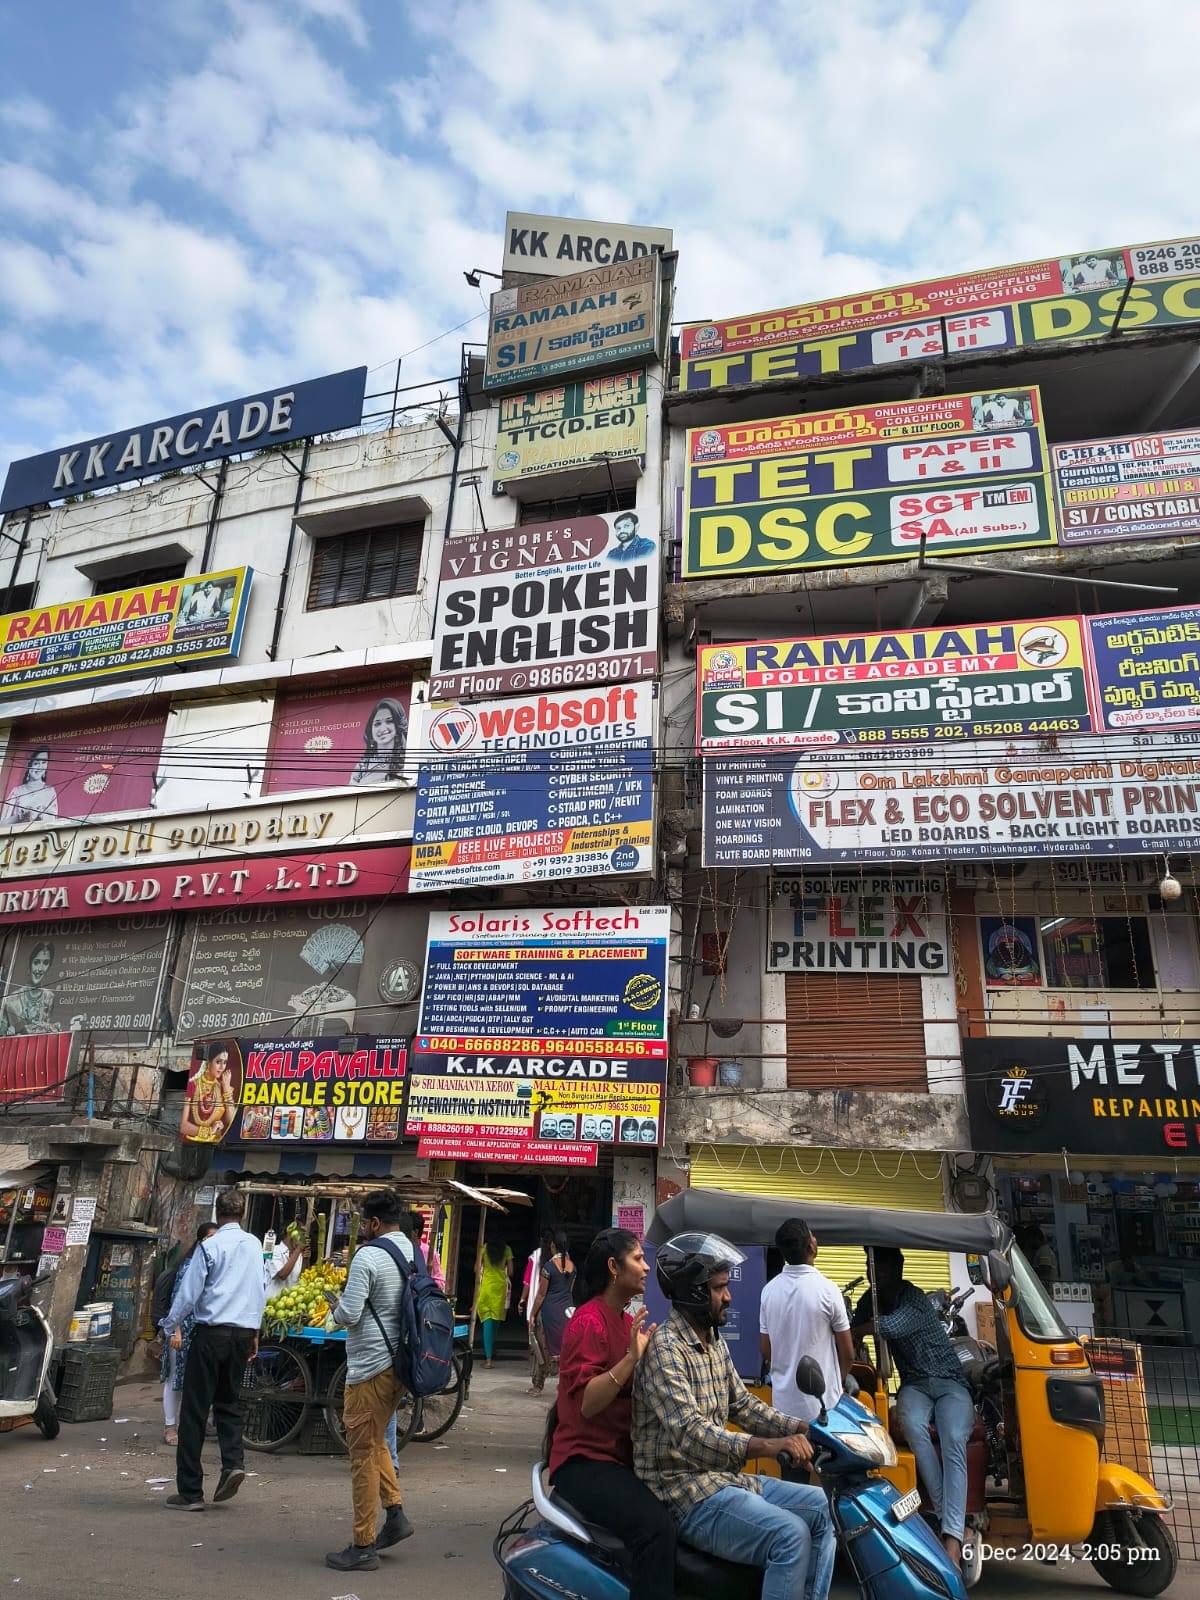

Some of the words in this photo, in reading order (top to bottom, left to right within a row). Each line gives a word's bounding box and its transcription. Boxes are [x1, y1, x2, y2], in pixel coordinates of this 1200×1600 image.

[509, 228, 549, 258] KK
[1136, 248, 1176, 261] 9246
[1139, 263, 1168, 275] 888
[928, 271, 1051, 300] ONLINE/OFFLINE
[944, 284, 1037, 307] COACHING
[494, 291, 617, 333] RAMAIAH
[885, 316, 991, 344] PAPER
[496, 341, 527, 369] SI
[694, 335, 858, 389] TET
[585, 370, 642, 398] NEET
[502, 388, 565, 421] IIT-JEE
[584, 388, 640, 410] EAMCET
[875, 401, 963, 417] ONLINE/OFFLINE
[508, 408, 635, 446] TTC(D.Ed)
[887, 412, 953, 426] COACHING
[930, 421, 960, 430] FLOOR
[115, 391, 297, 474] ARCADE
[902, 437, 1016, 460] PAPER
[1135, 439, 1160, 458] DSC
[941, 460, 966, 472] &
[979, 456, 1001, 469] II
[1060, 464, 1116, 478] Gurukula
[698, 448, 873, 504] TET
[1063, 474, 1119, 488] Teachers
[899, 491, 980, 517] SGT
[985, 491, 1005, 505] TM
[1009, 490, 1028, 503] EM
[1067, 487, 1119, 503] GROUP
[1069, 509, 1088, 525] SI
[1105, 500, 1200, 521] CONSTABL
[469, 528, 573, 554] KISHORE'S
[700, 502, 873, 568] DSC
[900, 518, 954, 541] SA
[449, 538, 593, 577] VIGNAN
[444, 565, 648, 627] SPOKEN
[7, 584, 180, 642] RAMAIAH
[6, 633, 71, 652] COMPETITIVE
[72, 623, 125, 640] COACHING
[127, 613, 170, 629] CENTER
[85, 634, 122, 646] GURUKULA
[439, 609, 648, 671] ENGLISH
[85, 641, 120, 653] TEACHERS
[746, 626, 1015, 671] RAMAIAH
[2, 673, 22, 684] K.K.
[24, 667, 60, 680] Arcade
[61, 663, 78, 673] Ph:
[80, 657, 105, 670] 9246
[108, 653, 127, 665] 208
[129, 645, 173, 660] 422,888
[176, 640, 203, 653] 5555
[206, 635, 227, 648] 202
[762, 666, 857, 685] POLICE
[867, 655, 999, 678] ACADEMY
[431, 679, 455, 697] 2nd
[460, 675, 502, 695] Floor
[529, 657, 643, 688] 9866293071
[479, 687, 639, 739] websoft
[714, 691, 783, 733] SI
[481, 722, 637, 753] TECHNOLOGIES
[859, 729, 886, 741] 888
[892, 727, 929, 740] 5555
[934, 724, 968, 739] 202,
[973, 722, 1023, 737] 85208
[1029, 719, 1081, 734] 44463
[746, 773, 784, 783] PRINTING
[860, 772, 897, 789] Om
[903, 768, 988, 788] Lakshmi
[995, 761, 1113, 785] Ganapathi
[427, 807, 447, 818] DATA
[449, 801, 494, 816] ANALYTICS
[558, 801, 587, 813] STAAD
[716, 803, 765, 814] LAMINATION
[809, 798, 877, 828] FLEX
[884, 799, 905, 825] &
[914, 794, 970, 825] ECO
[978, 787, 1114, 822] SOLVENT
[1122, 784, 1200, 816] PRIN
[448, 827, 474, 840] AZURE
[475, 823, 504, 837] CLOUD,
[506, 820, 538, 833] DEVOPS
[573, 827, 620, 840] Internships
[716, 820, 732, 829] ONE
[734, 819, 752, 828] WAY
[754, 818, 781, 827] VISION
[881, 828, 913, 844] LED
[919, 825, 990, 843] BOARDS
[1010, 823, 1059, 839] BACK
[1066, 820, 1120, 837] LIGHT
[79, 822, 155, 863] gold
[168, 809, 334, 849] company
[458, 841, 480, 854] IEEE
[484, 838, 506, 852] LIVE
[509, 832, 564, 848] PROJECTS
[571, 839, 612, 850] Industrial
[615, 835, 650, 847] Training
[716, 834, 763, 844] HOARDINGS
[415, 846, 442, 858] MBA
[549, 855, 573, 865] 9392
[575, 852, 609, 863] 313836
[616, 850, 634, 860] 2nd
[742, 849, 770, 858] BOARD
[772, 848, 812, 858] PRINTING
[548, 866, 572, 877] 8019
[84, 877, 162, 907] GOLD
[804, 879, 868, 894] SOLVENT
[872, 878, 941, 893] PRINTING
[449, 912, 530, 933] Solaris
[543, 908, 639, 931] Softech
[794, 896, 926, 938] FLEX
[456, 950, 511, 960] SOFTWARE
[515, 949, 563, 959] TRAINING
[567, 950, 574, 958] &
[579, 948, 645, 959] PLACEMENT
[770, 941, 944, 970] PRINTING
[452, 962, 472, 970] STACK
[473, 962, 518, 970] DEVELOPMENT
[113, 1014, 131, 1028] 300
[133, 1013, 150, 1027] 600
[487, 1026, 533, 1034] DEVELOPMENT
[631, 1021, 657, 1031] Floor
[246, 1049, 407, 1081] KALPAVALLI
[446, 1056, 628, 1078] K.K.ARCADE
[1067, 1044, 1200, 1091] MET
[243, 1081, 327, 1106] BANGLE
[333, 1080, 404, 1105] STORE
[422, 1079, 436, 1090] SRI
[437, 1079, 485, 1091] MANIKANTA
[485, 1080, 515, 1092] XEROX
[533, 1080, 577, 1092] MALATI
[581, 1082, 612, 1094] HAIR
[616, 1083, 659, 1095] STUDIO
[410, 1095, 476, 1116] TYPEWRITING
[478, 1098, 531, 1118] INSTITUTE
[480, 1127, 528, 1136] 9701229924
[619, 1209, 643, 1217] TO-LET
